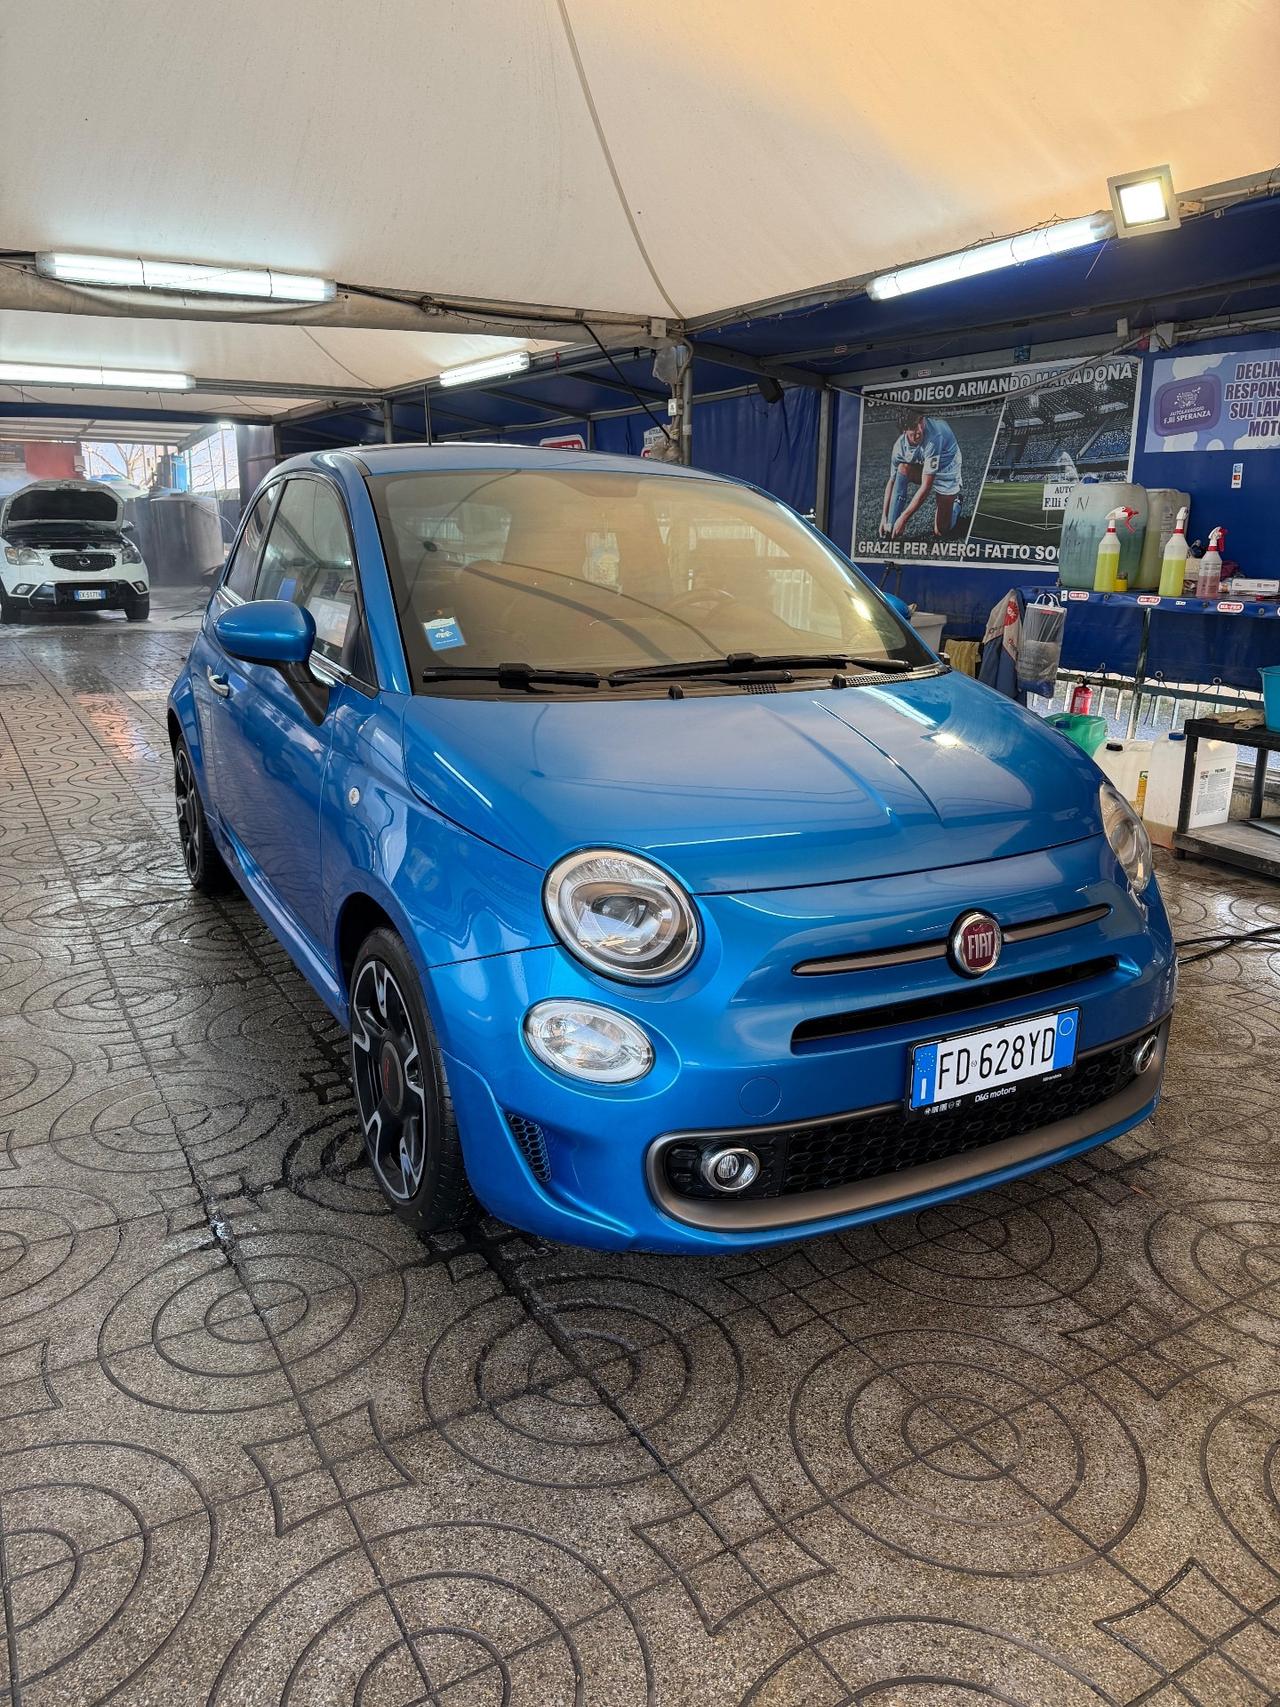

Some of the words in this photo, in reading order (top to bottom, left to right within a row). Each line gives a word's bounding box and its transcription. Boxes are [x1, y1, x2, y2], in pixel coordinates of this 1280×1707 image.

[913, 384, 954, 402] DIEGO
[957, 374, 1031, 398] ARMANDO
[1035, 362, 1133, 388] MARADONA
[1176, 410, 1211, 422] SPERANZA
[1230, 402, 1254, 419] SUL
[1256, 400, 1280, 418] LAV
[1248, 420, 1280, 437] MOT
[1044, 497, 1061, 508] F.lli
[858, 541, 900, 555] GRAZIE
[903, 541, 928, 556] PER
[931, 542, 980, 558] AVERCI
[984, 543, 1031, 560] FATTO
[968, 931, 993, 960] FIAT
[938, 1049, 971, 1090] FD
[979, 1027, 1056, 1078] 628YD
[989, 1086, 1017, 1099] motors
